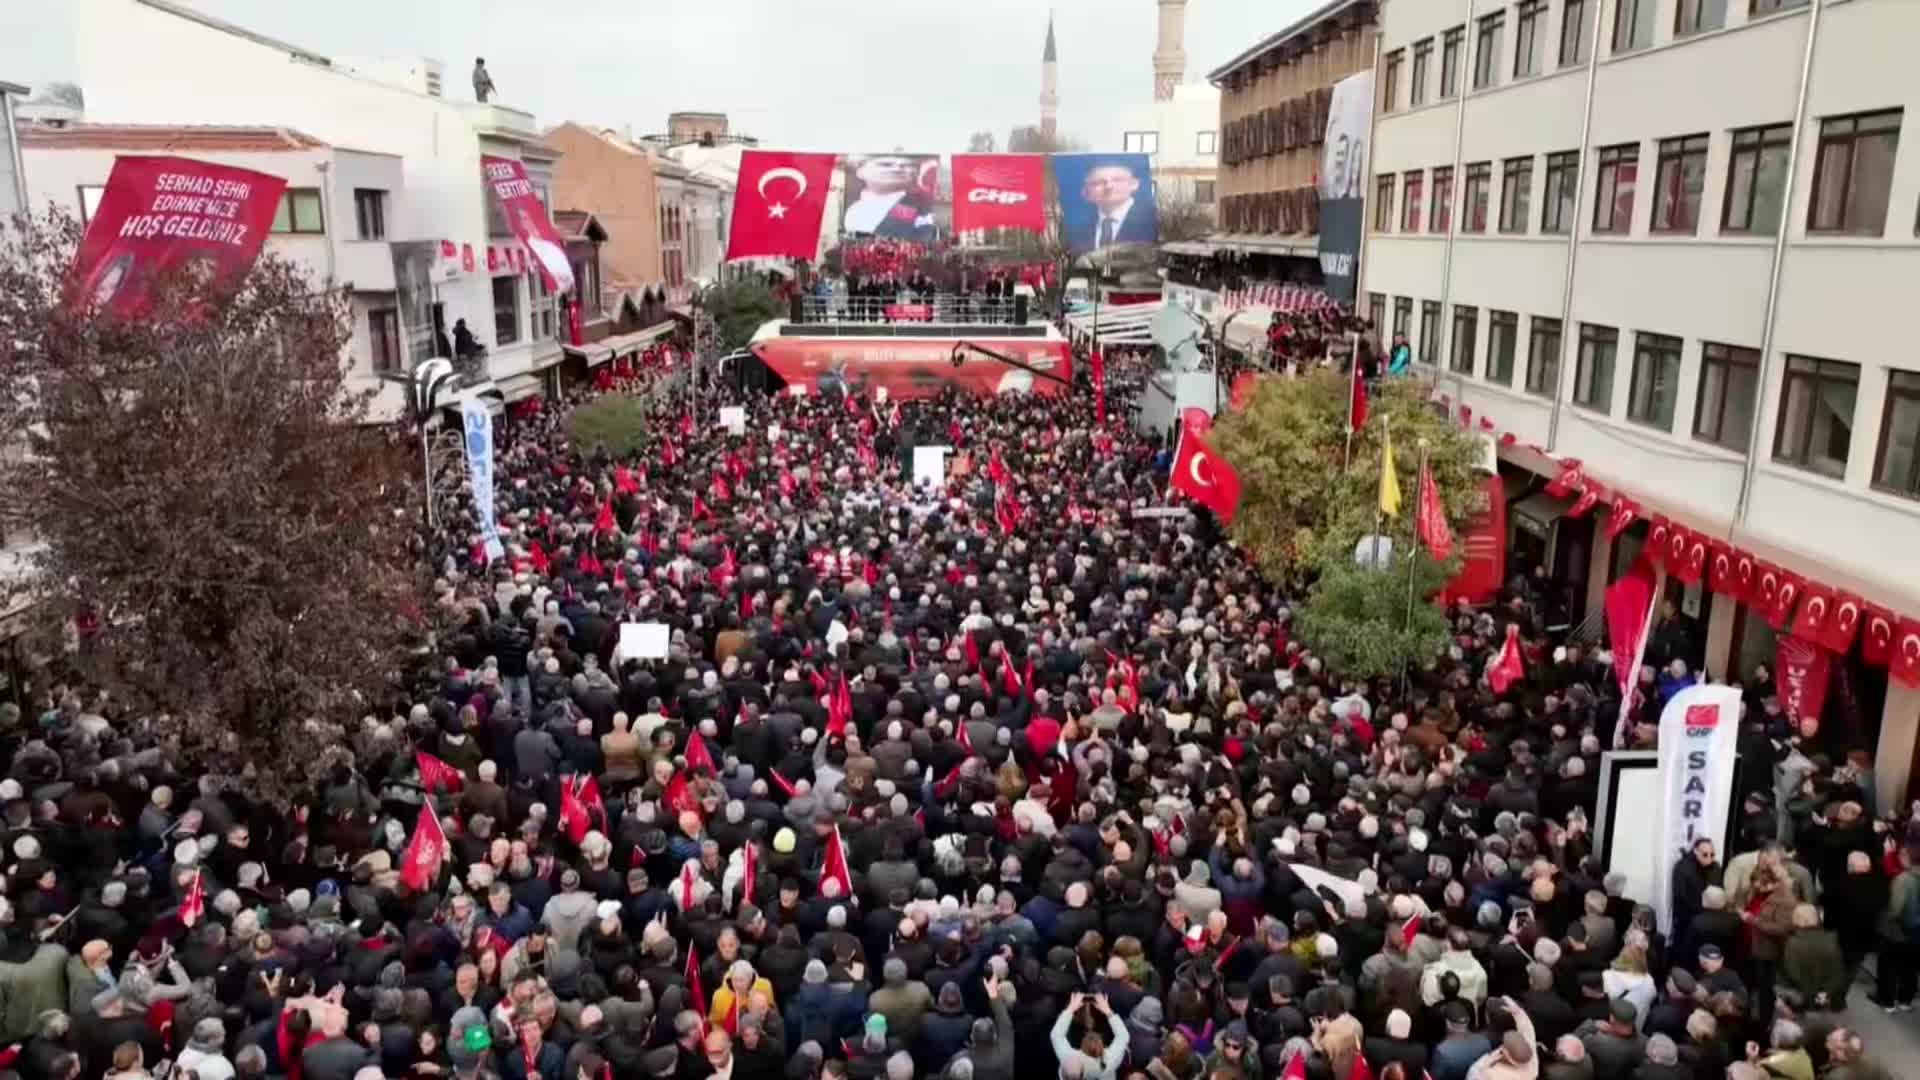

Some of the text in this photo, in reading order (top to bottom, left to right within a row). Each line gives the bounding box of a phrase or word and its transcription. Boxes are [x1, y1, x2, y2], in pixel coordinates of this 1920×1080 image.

[155, 174, 213, 194] SERHAD
[968, 187, 1027, 204] CHP
[119, 215, 248, 245] HOŞ GELDİNİZ
